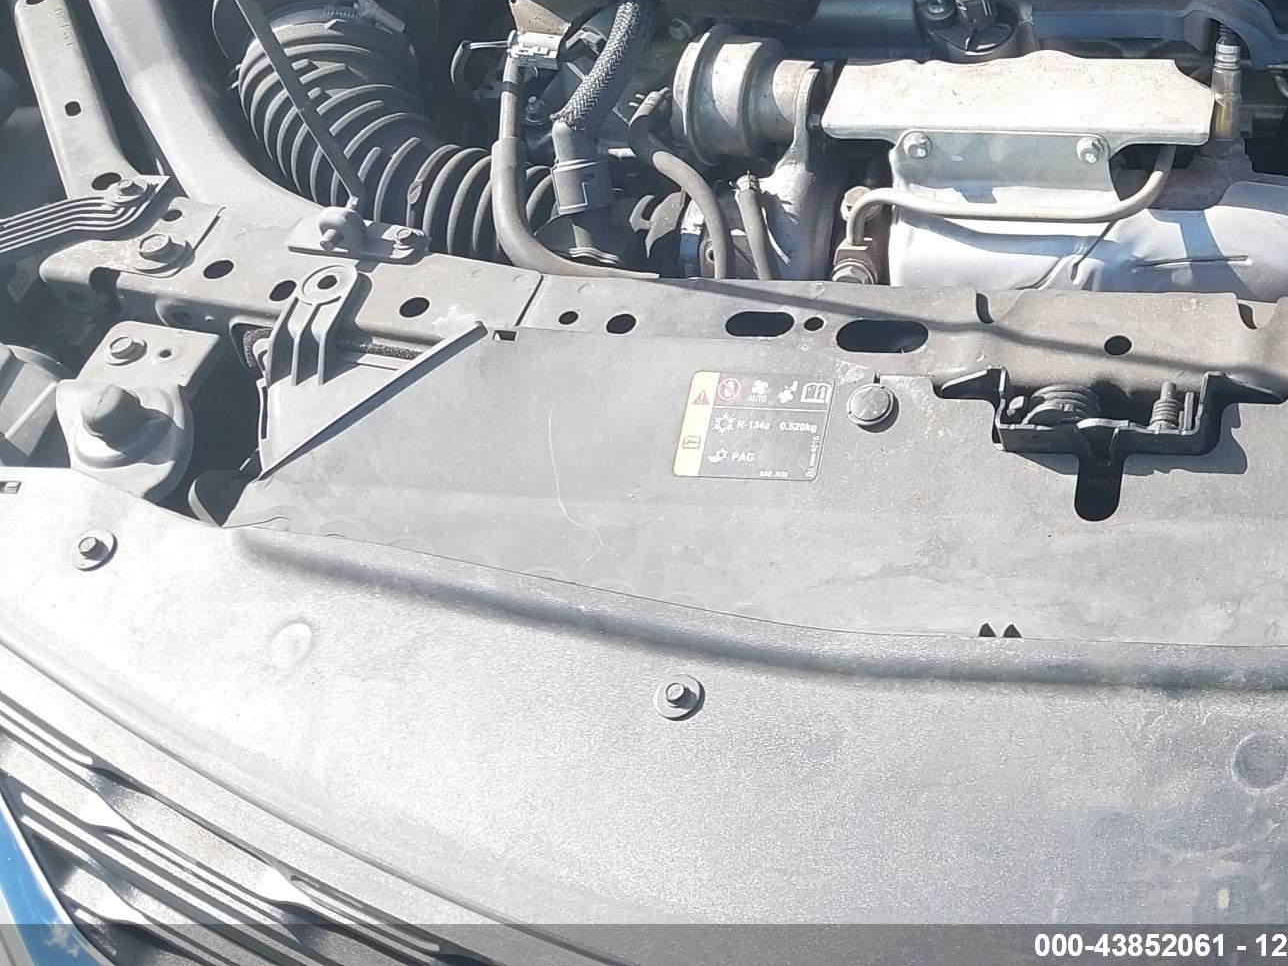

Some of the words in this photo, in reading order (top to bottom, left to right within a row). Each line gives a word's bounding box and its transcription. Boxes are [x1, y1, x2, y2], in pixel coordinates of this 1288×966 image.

[748, 394, 767, 403] AUTO
[736, 420, 770, 431] R-134a
[779, 422, 818, 434] 0.520kg
[731, 452, 755, 462] PAG
